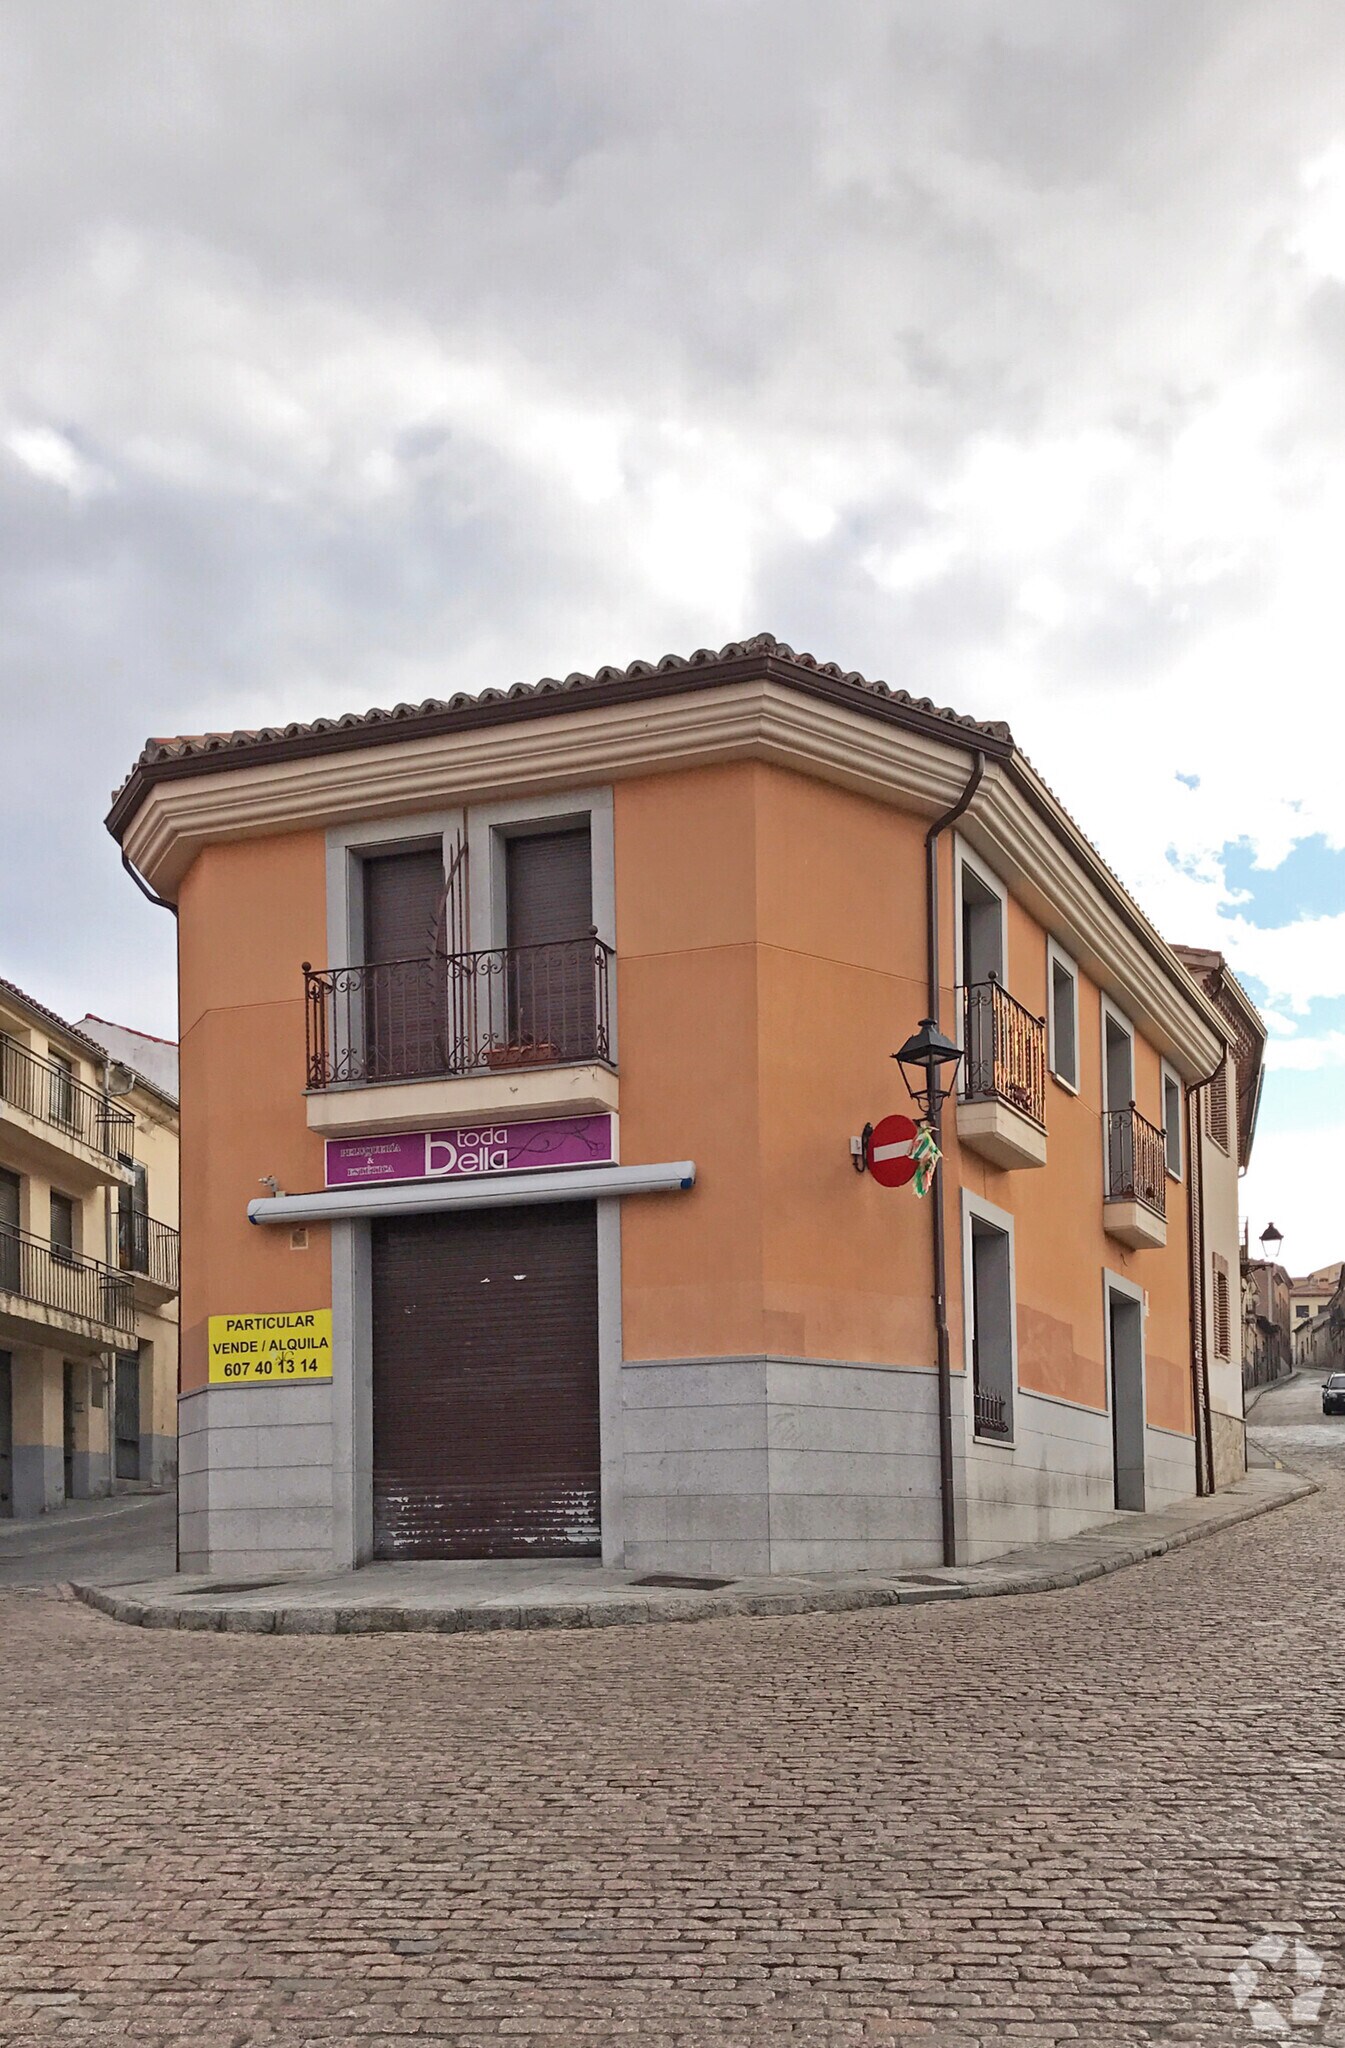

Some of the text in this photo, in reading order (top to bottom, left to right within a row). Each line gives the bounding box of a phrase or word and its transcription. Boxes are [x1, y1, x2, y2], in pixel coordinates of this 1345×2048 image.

[457, 1128, 508, 1147] toda
[226, 1315, 315, 1331] PARTICULAR
[213, 1341, 258, 1354] VENDE
[269, 1337, 329, 1351] ALQUILA
[224, 1358, 318, 1376] 607 40 13 14
